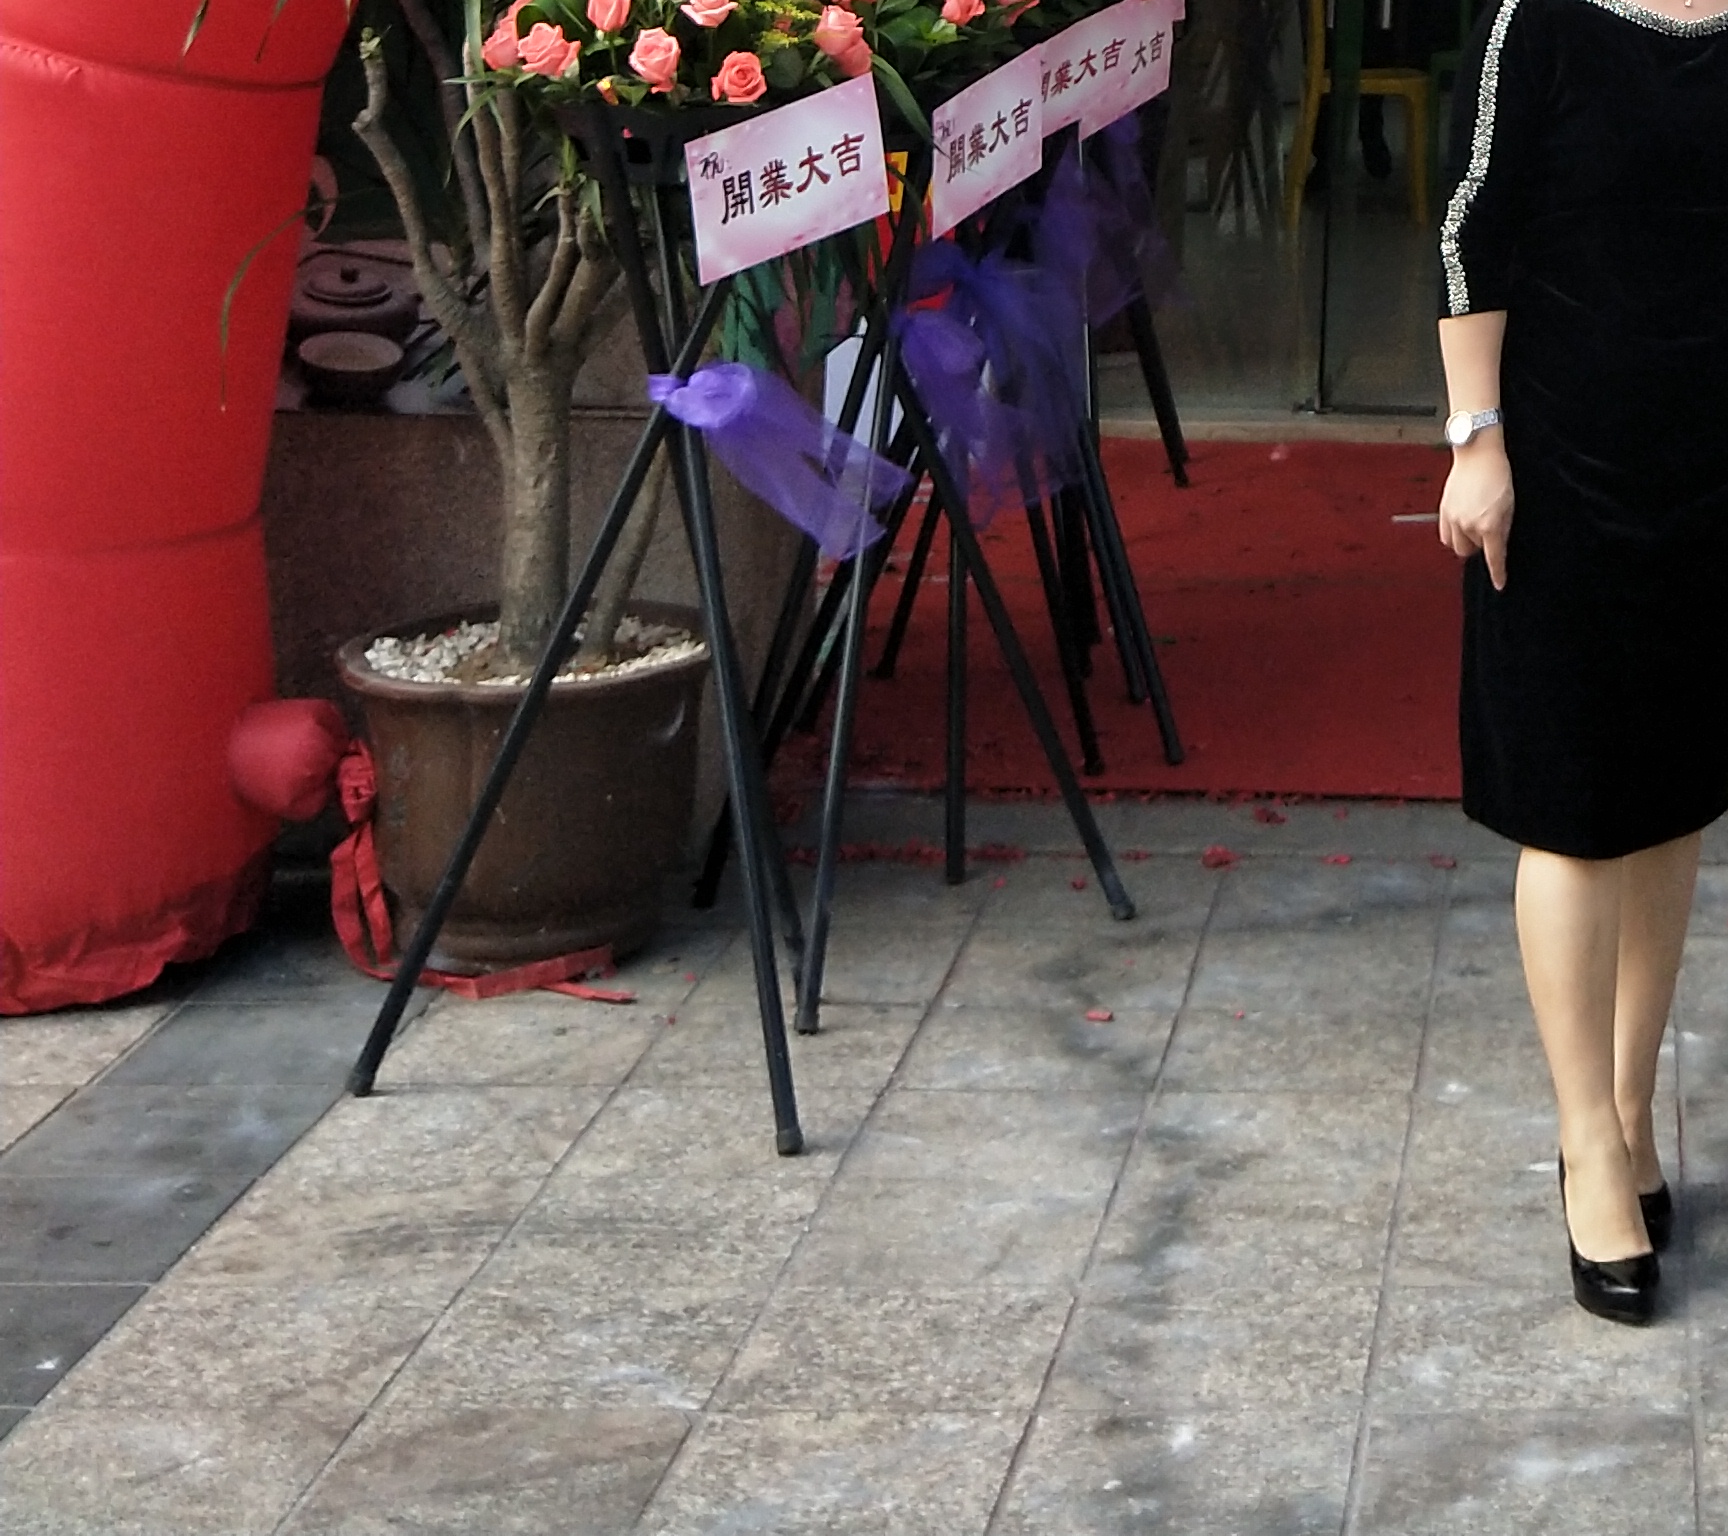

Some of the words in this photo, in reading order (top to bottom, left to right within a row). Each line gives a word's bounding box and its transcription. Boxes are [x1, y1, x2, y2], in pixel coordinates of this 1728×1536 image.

[1131, 31, 1167, 76] 大吉
[721, 132, 866, 225] 開業大吉
[946, 97, 1034, 184] 開業大吉
